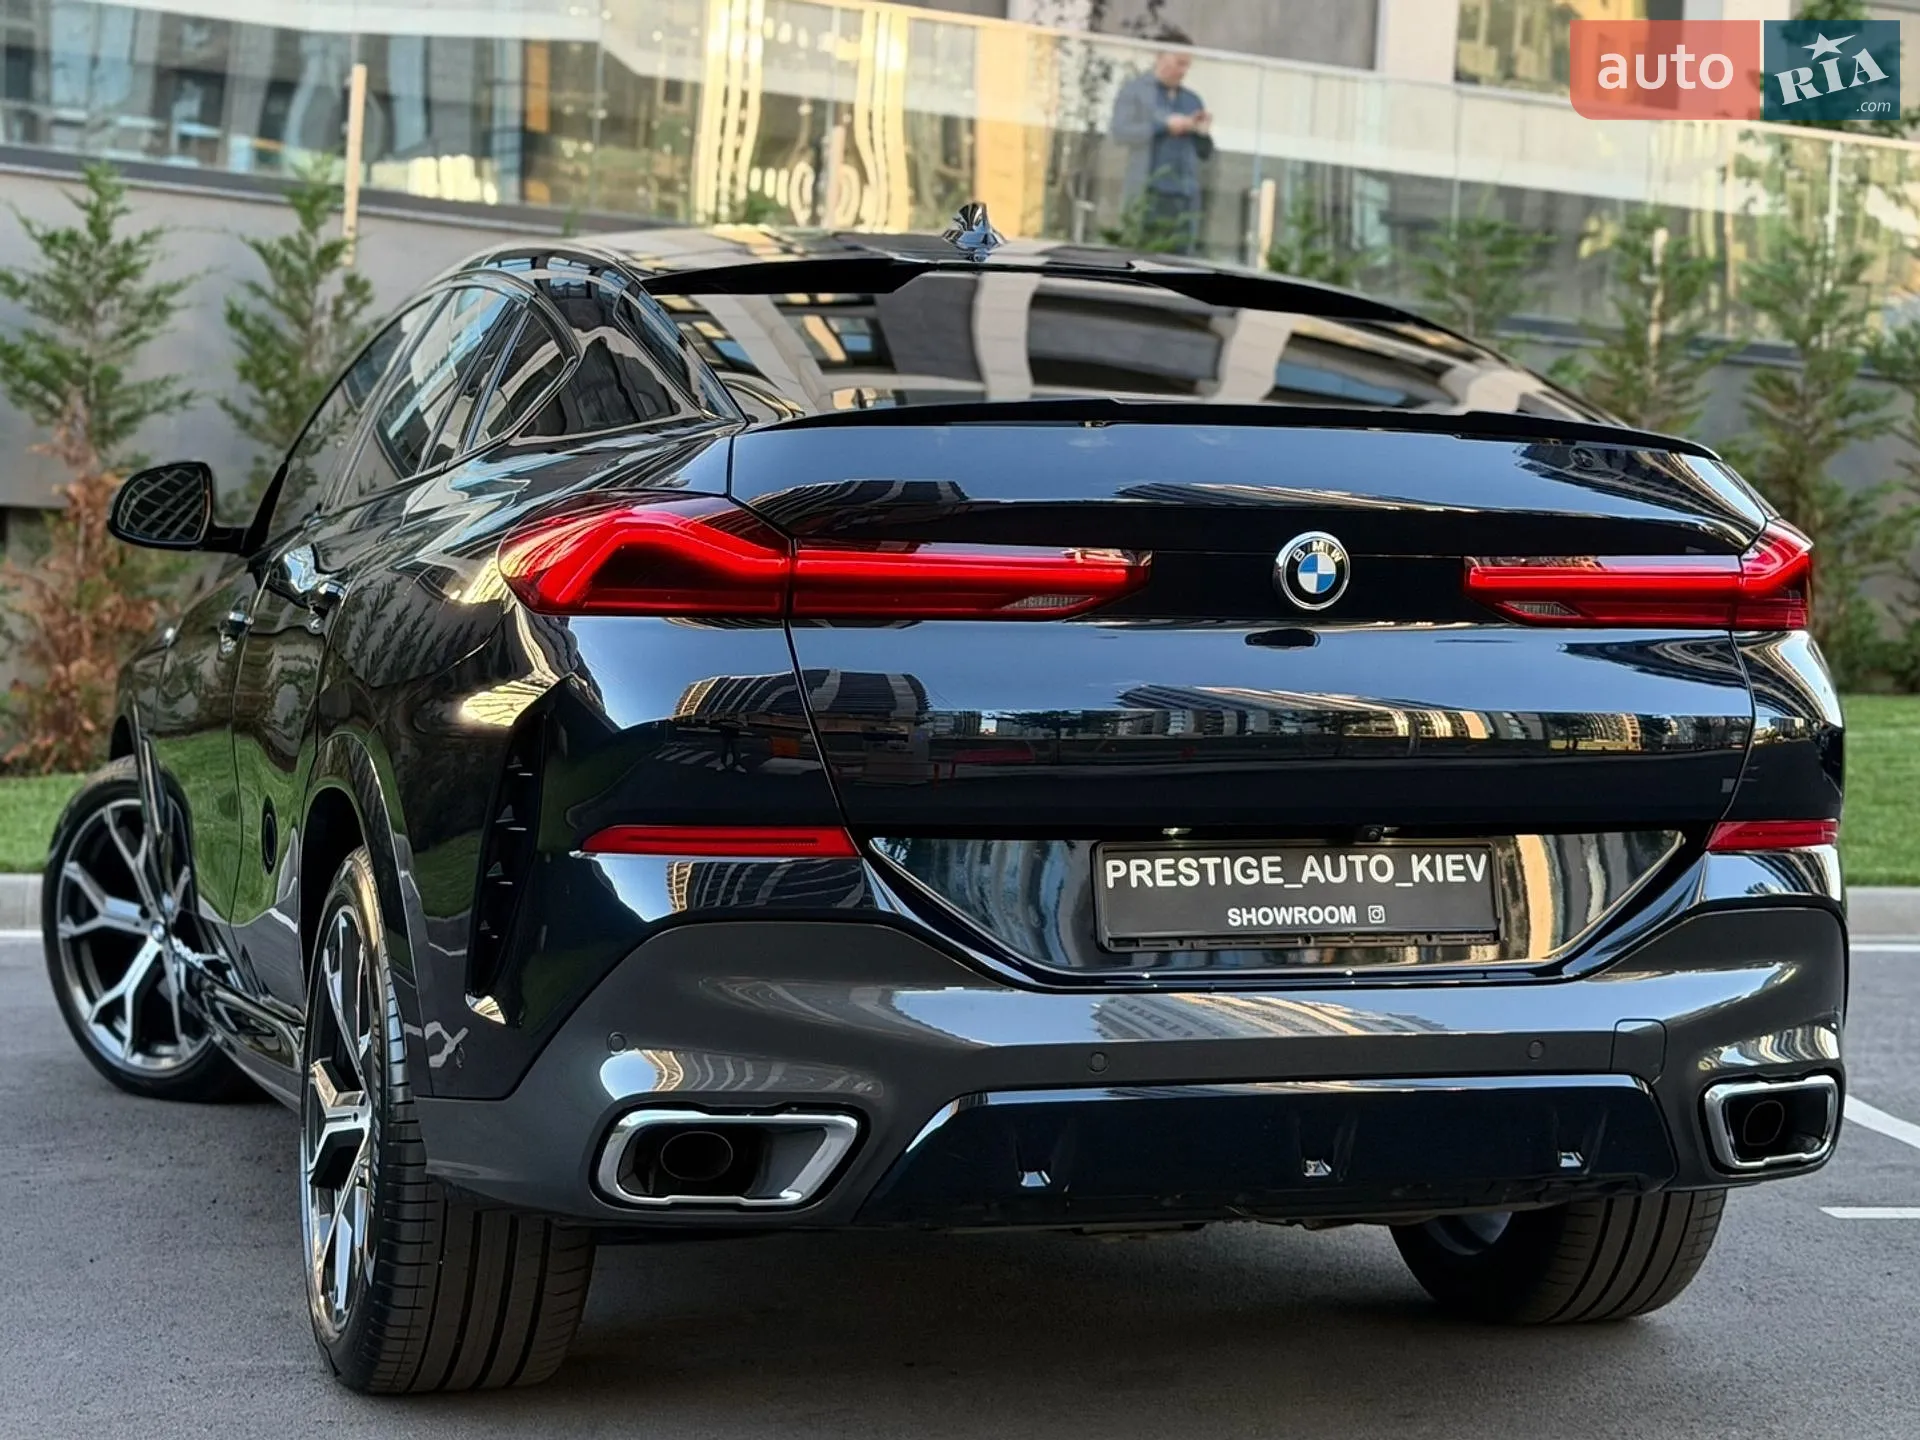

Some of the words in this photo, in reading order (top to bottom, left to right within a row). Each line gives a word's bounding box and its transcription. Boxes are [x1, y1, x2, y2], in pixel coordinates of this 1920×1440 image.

[1292, 541, 1343, 562] BMW
[1106, 854, 1487, 889] PRESTIGE_AUTO_KIEV
[1227, 905, 1357, 926] SHOWROOM
